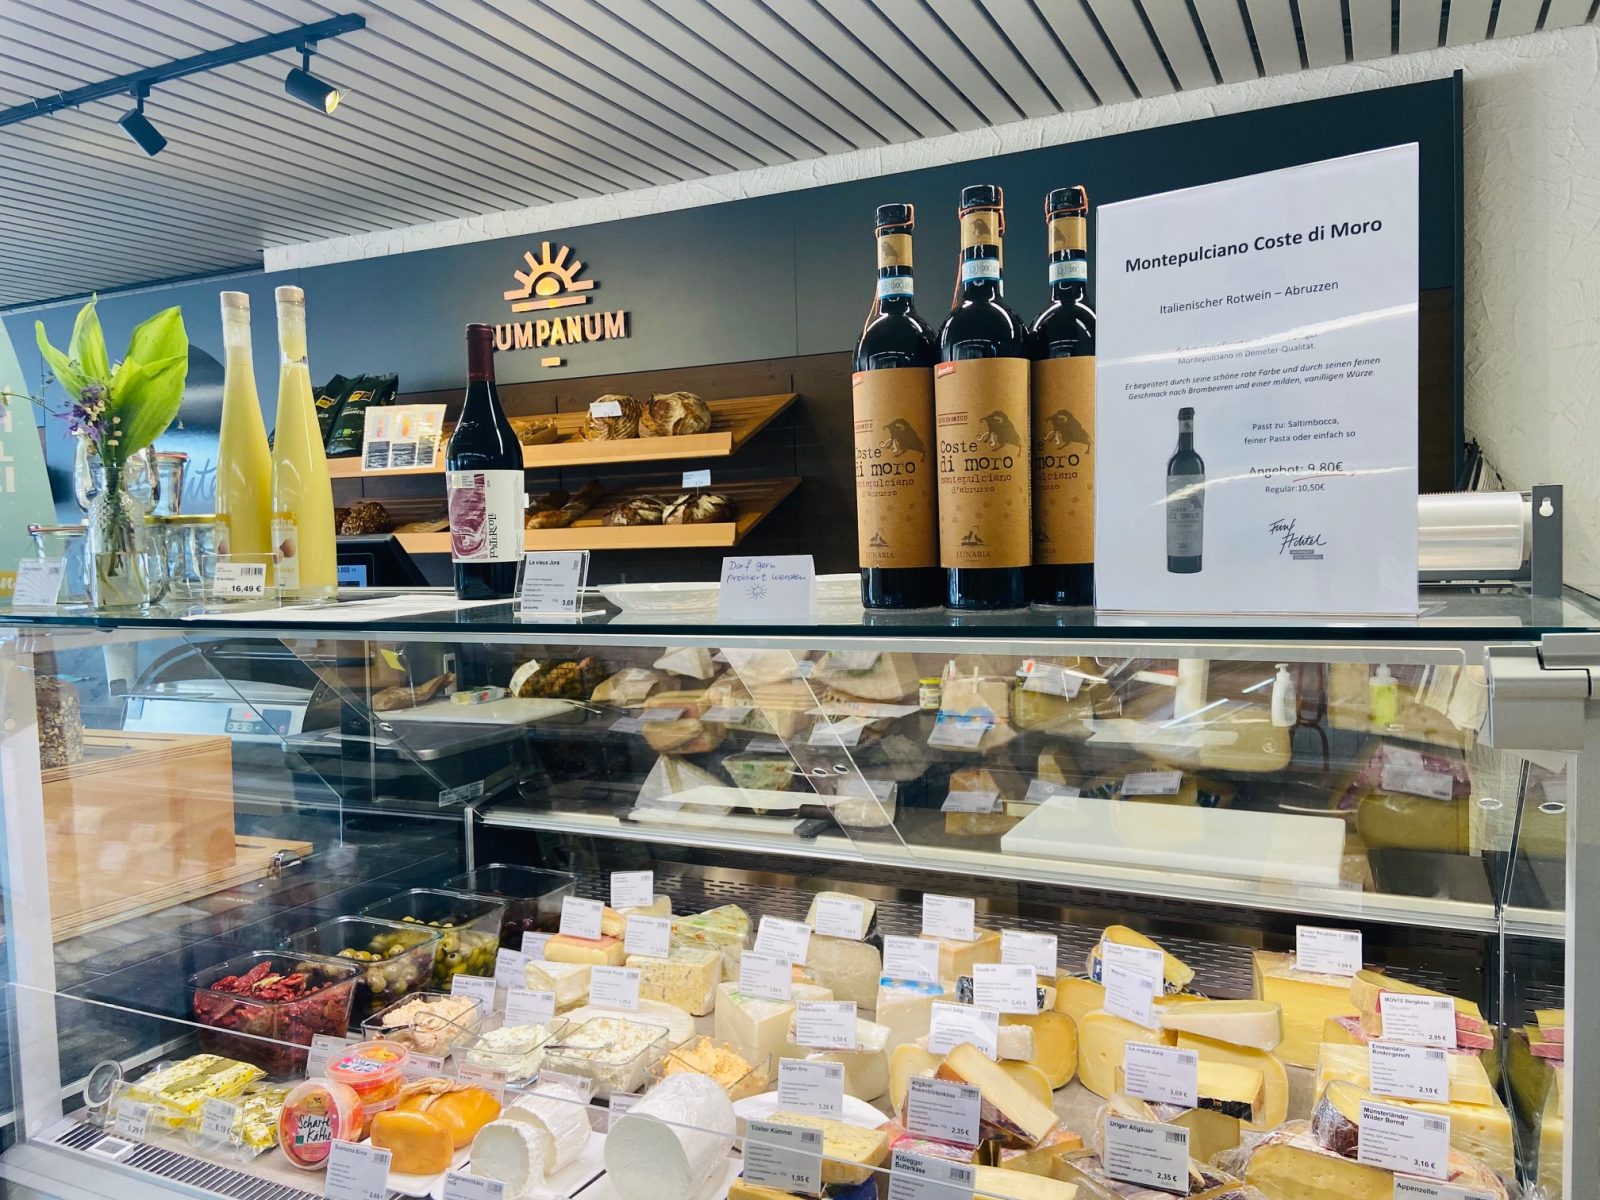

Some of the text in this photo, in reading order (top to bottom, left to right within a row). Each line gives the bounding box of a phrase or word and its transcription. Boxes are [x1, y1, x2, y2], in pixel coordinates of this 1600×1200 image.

[1125, 220, 1382, 273] Montepulciano Coste di Moro
[1160, 297, 1223, 315] Italienischer
[1227, 290, 1272, 304] Rotwein
[1284, 281, 1339, 297] Abruzzen
[492, 310, 625, 350] UMPANUM
[1178, 352, 1234, 365] Montepulciano
[1134, 380, 1168, 390] begeistert
[1170, 377, 1191, 386] durch
[1213, 372, 1239, 381] schöne
[1240, 370, 1256, 378] rote
[1259, 368, 1281, 376] Farbe
[1300, 362, 1322, 372] durch
[1325, 361, 1352, 369] seinen
[1353, 358, 1380, 368] feinen
[1128, 390, 1167, 400] Geschmack
[1273, 378, 1302, 386] milden,
[1304, 373, 1343, 382] vanilligen
[1288, 418, 1339, 428] Saltimbocca,
[1314, 430, 1344, 439] einfach
[940, 440, 978, 454] Coste
[871, 462, 916, 476] moro
[940, 456, 1013, 472] di moro
[956, 551, 991, 559] LUNARIA
[728, 559, 752, 570] Darf
[298, 1110, 330, 1130] Scharfe
[1363, 1113, 1384, 1122] Wilder
[1110, 1121, 1154, 1134] Uriger Allgäuer
[306, 1127, 332, 1143] Käthe
[1157, 1172, 1172, 1180] 2,35
[1396, 1182, 1438, 1196] Appenzeller
